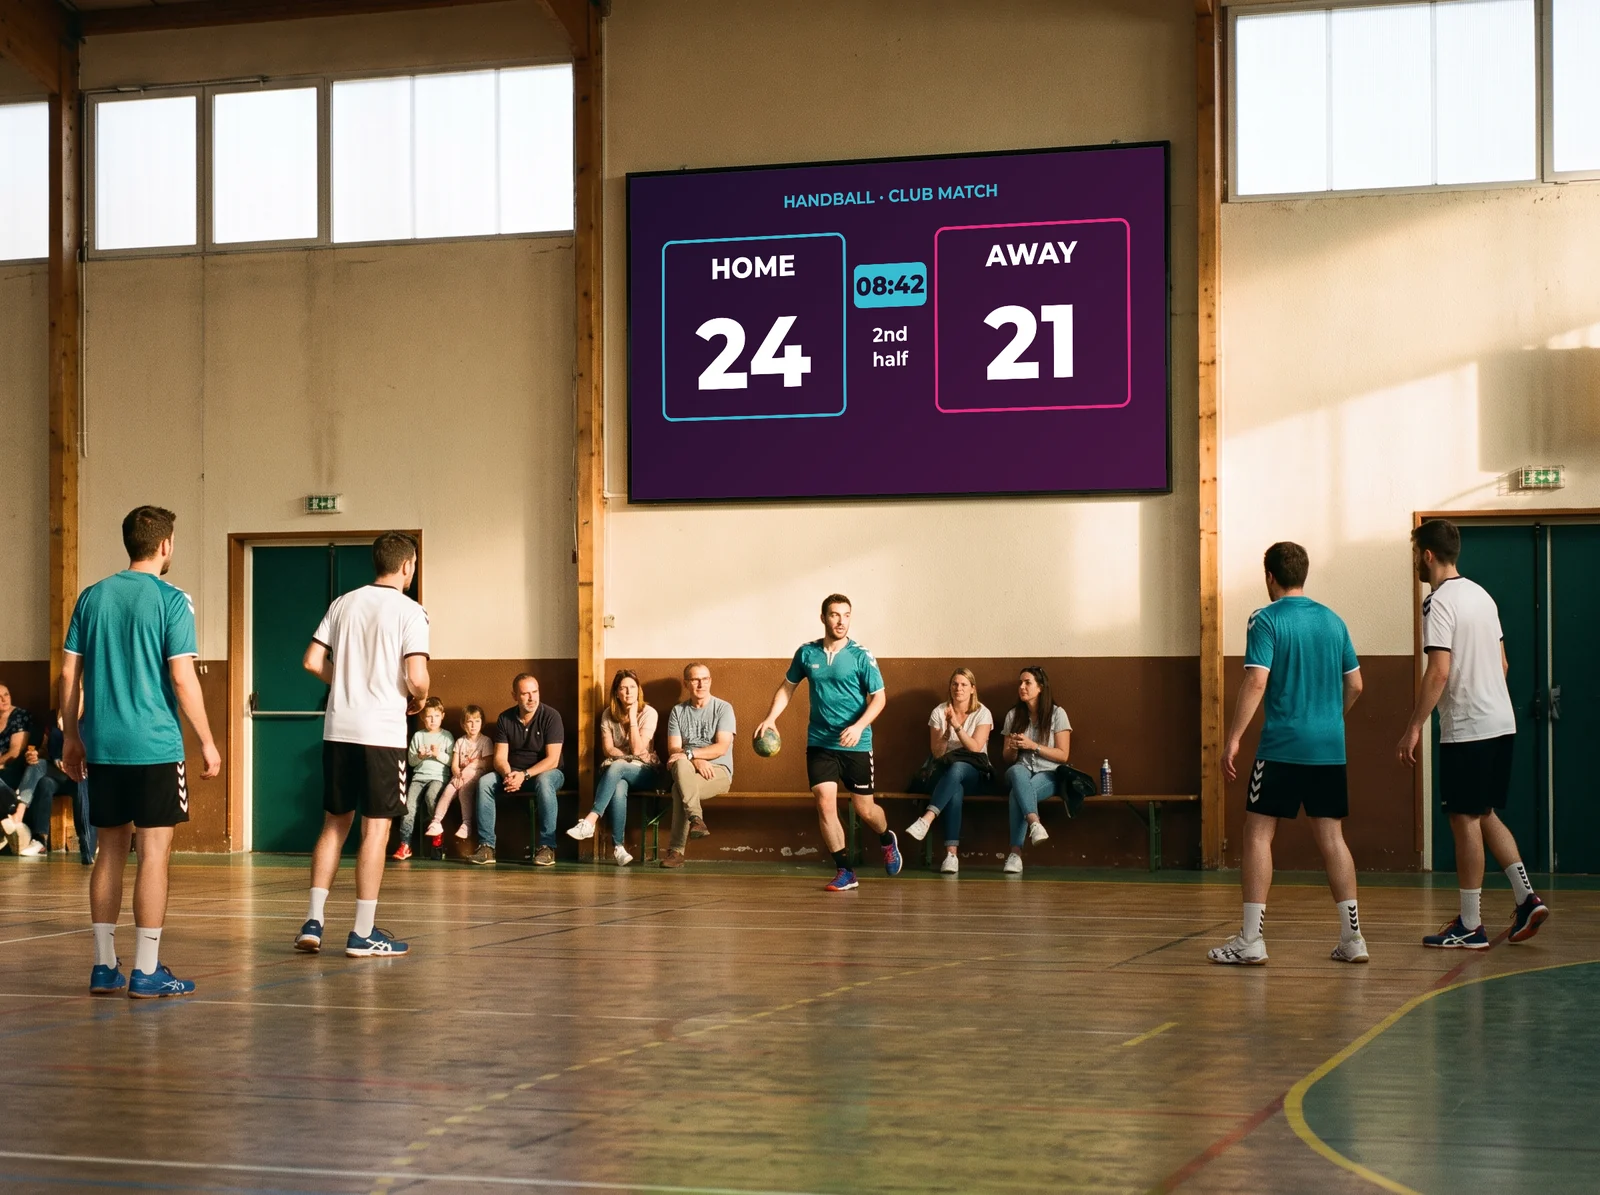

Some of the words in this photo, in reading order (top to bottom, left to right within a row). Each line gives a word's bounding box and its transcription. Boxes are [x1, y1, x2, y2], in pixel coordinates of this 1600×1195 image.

[784, 190, 875, 209] HANDBALL
[888, 187, 934, 203] CLUB
[938, 183, 998, 200] MATCH
[711, 254, 796, 280] HOME
[985, 240, 1078, 268] AWAY
[856, 274, 925, 296] 08:42
[872, 325, 908, 343] 2nd
[983, 304, 1074, 381] 21
[695, 315, 812, 391] 24
[873, 350, 909, 368] half
